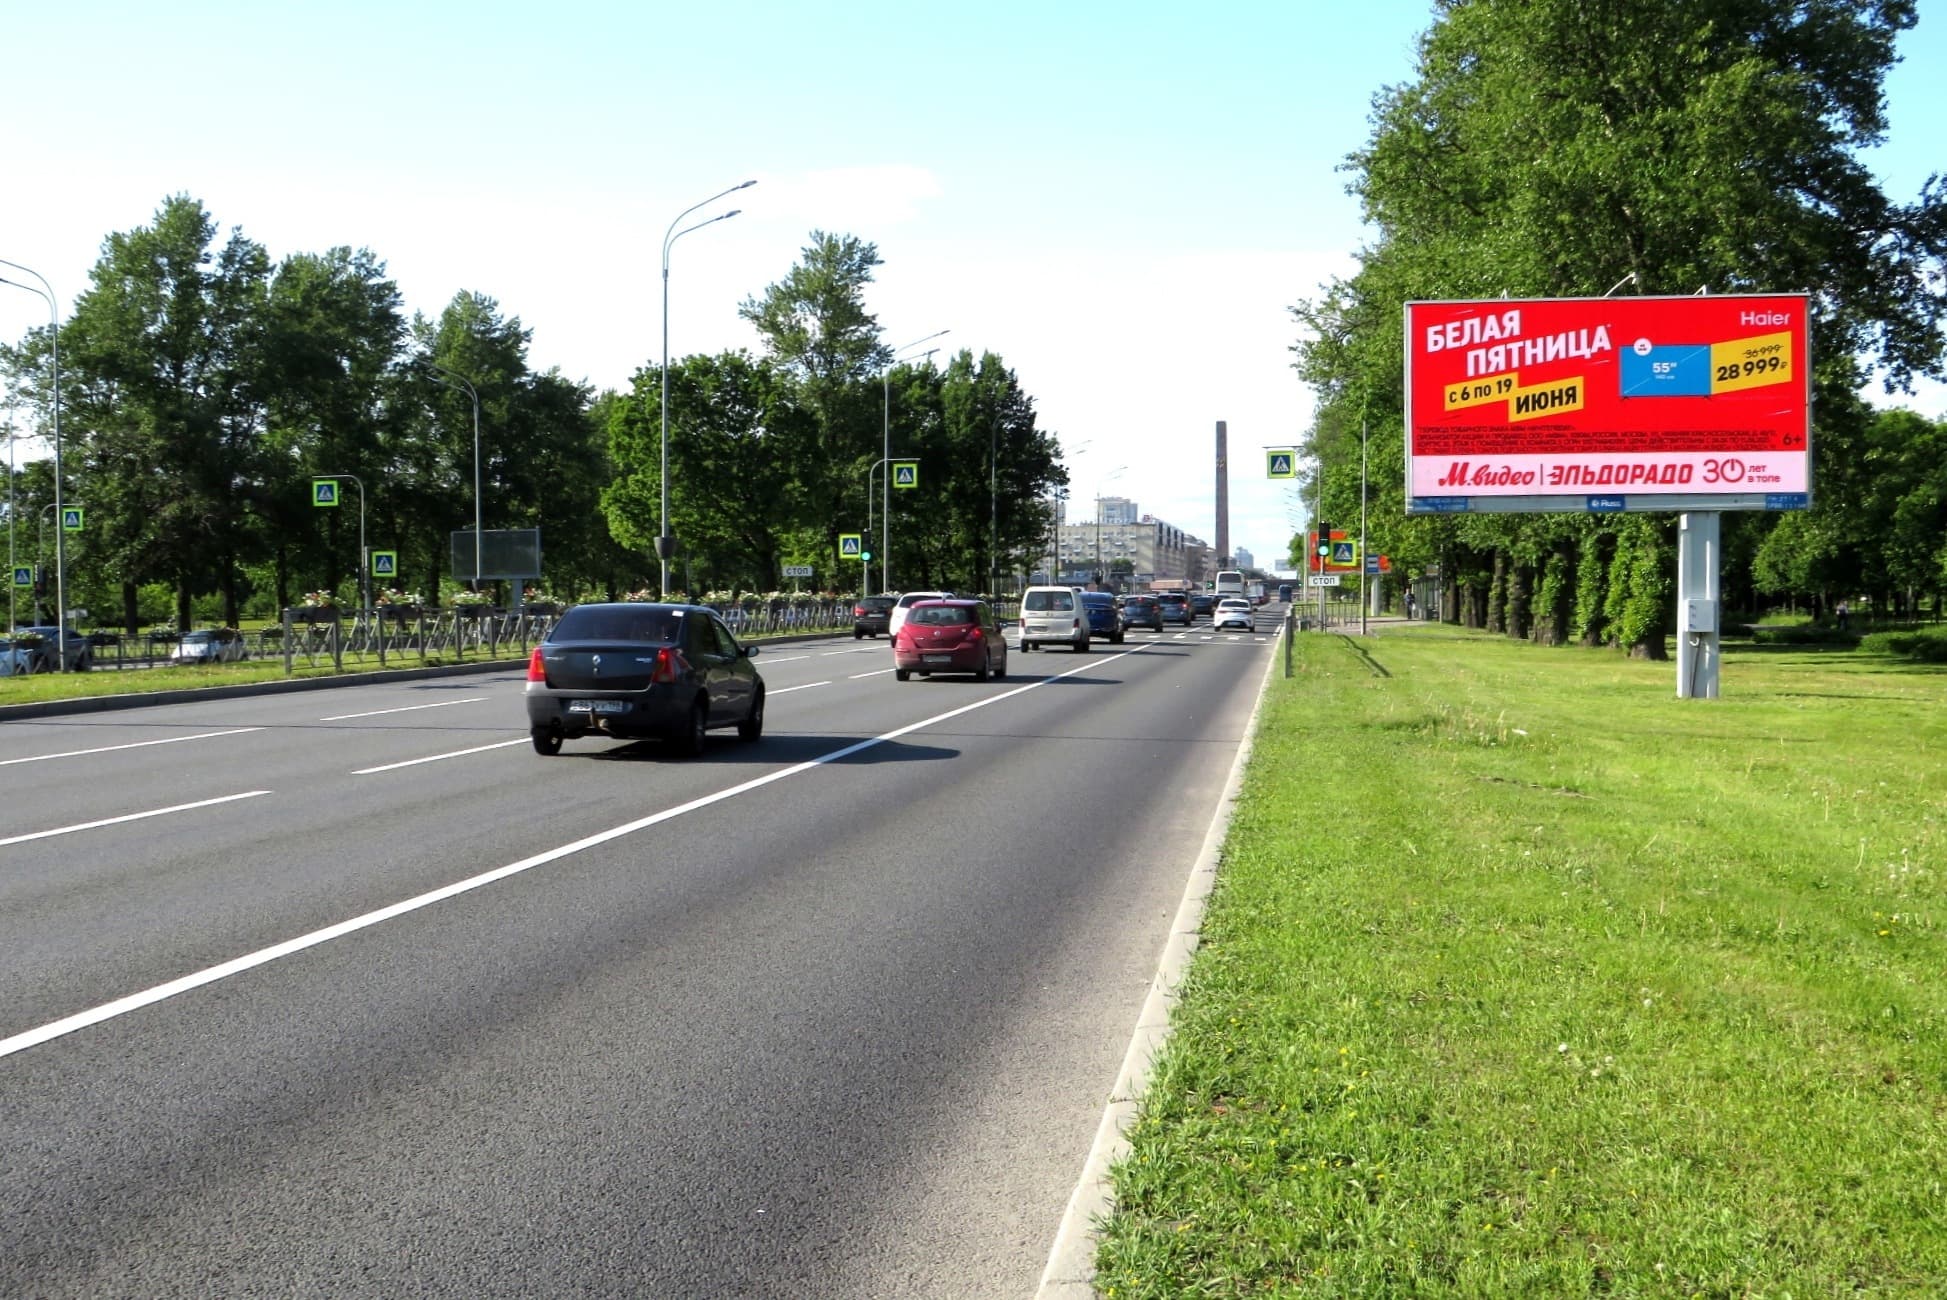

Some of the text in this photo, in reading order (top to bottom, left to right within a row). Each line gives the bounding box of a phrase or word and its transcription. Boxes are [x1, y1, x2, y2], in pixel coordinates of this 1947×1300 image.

[1740, 311, 1791, 326] Haier
[1427, 309, 1520, 353] БЕЛАЯ
[1716, 364, 1740, 382] 28
[1460, 386, 1470, 401] 6
[1497, 378, 1513, 394] 19
[1515, 385, 1577, 414] ИЮНЯ
[1782, 433, 1802, 446] 6+
[1548, 463, 1694, 486] ЭЛЬДОРАДО
[1748, 464, 1767, 473] лет
[1747, 475, 1781, 483] в топе
[786, 567, 809, 575] СТОП
[1312, 577, 1335, 585] СТОП
